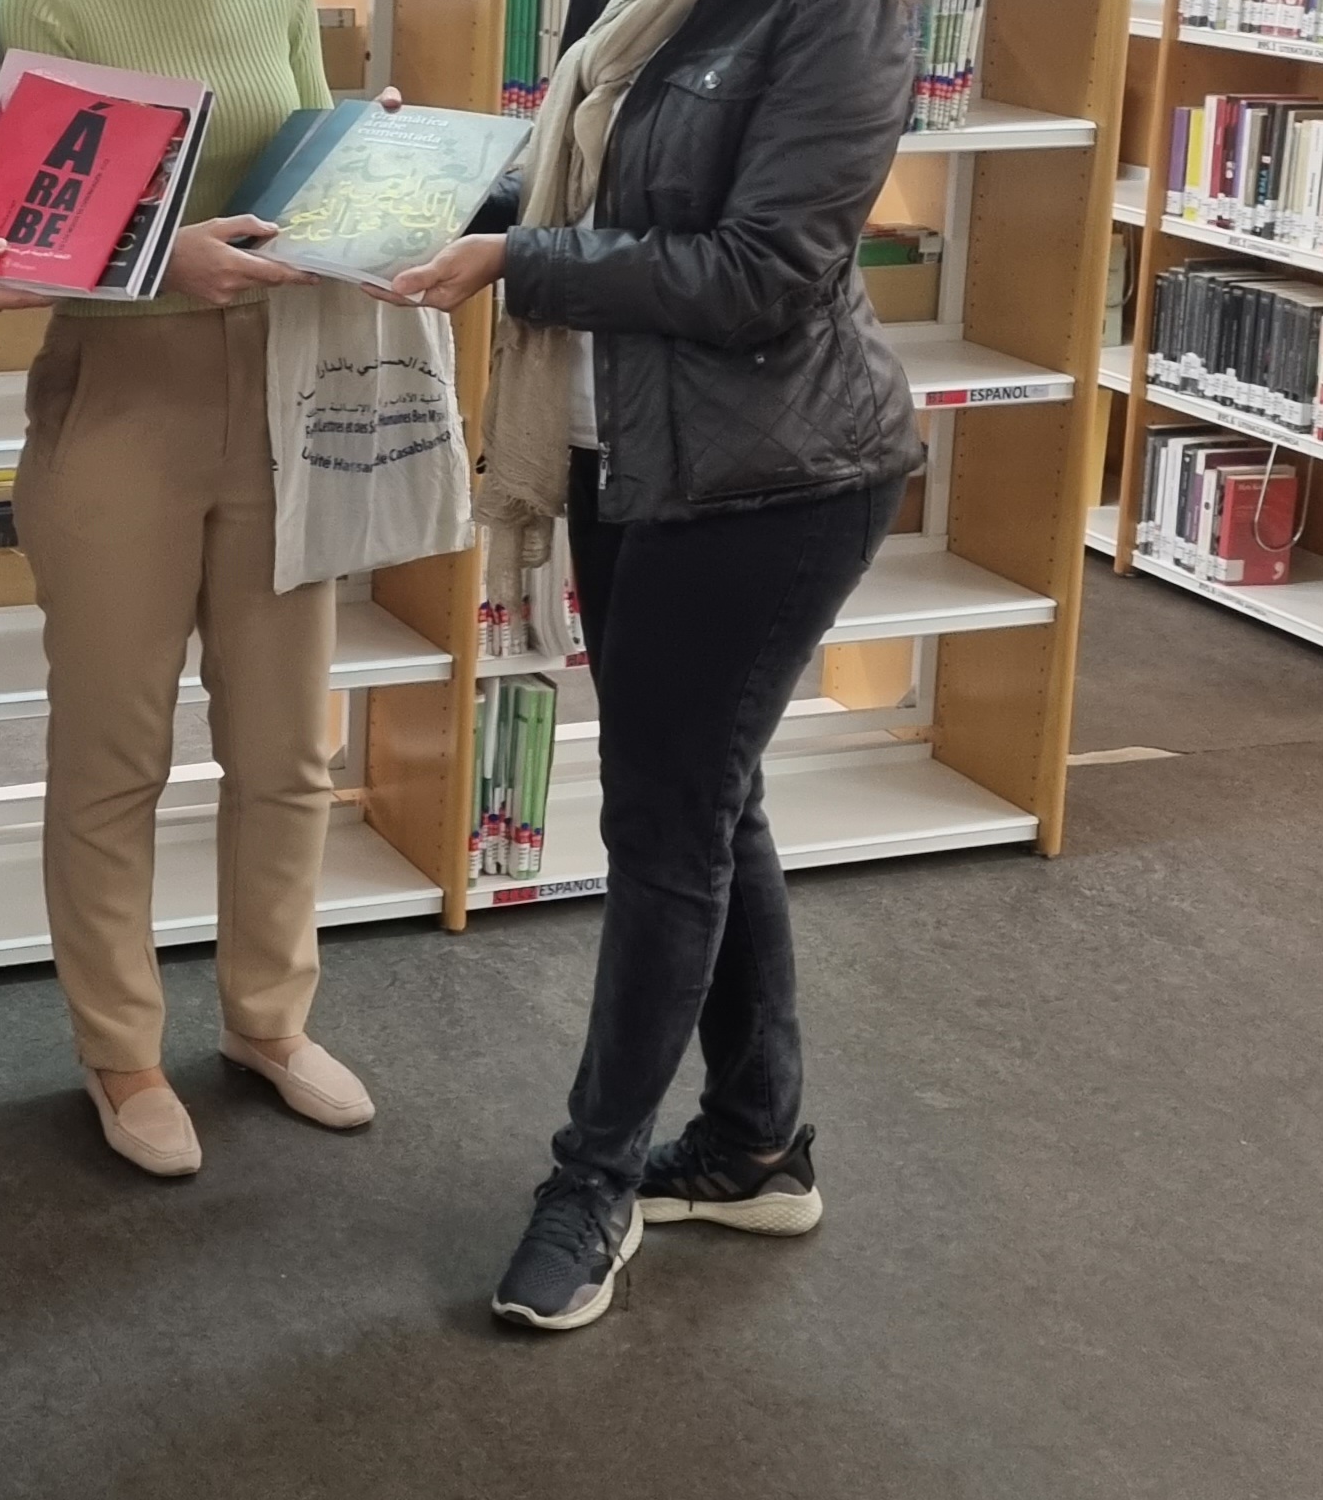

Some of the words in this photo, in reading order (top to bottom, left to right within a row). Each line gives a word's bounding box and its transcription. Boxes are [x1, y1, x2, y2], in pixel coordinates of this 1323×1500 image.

[358, 126, 442, 144] comentada
[364, 120, 407, 130] árabe
[370, 110, 448, 128] Gramática
[41, 101, 114, 176] Á
[25, 170, 82, 212] RA
[4, 205, 69, 248] BE
[389, 430, 451, 462] Casablanca
